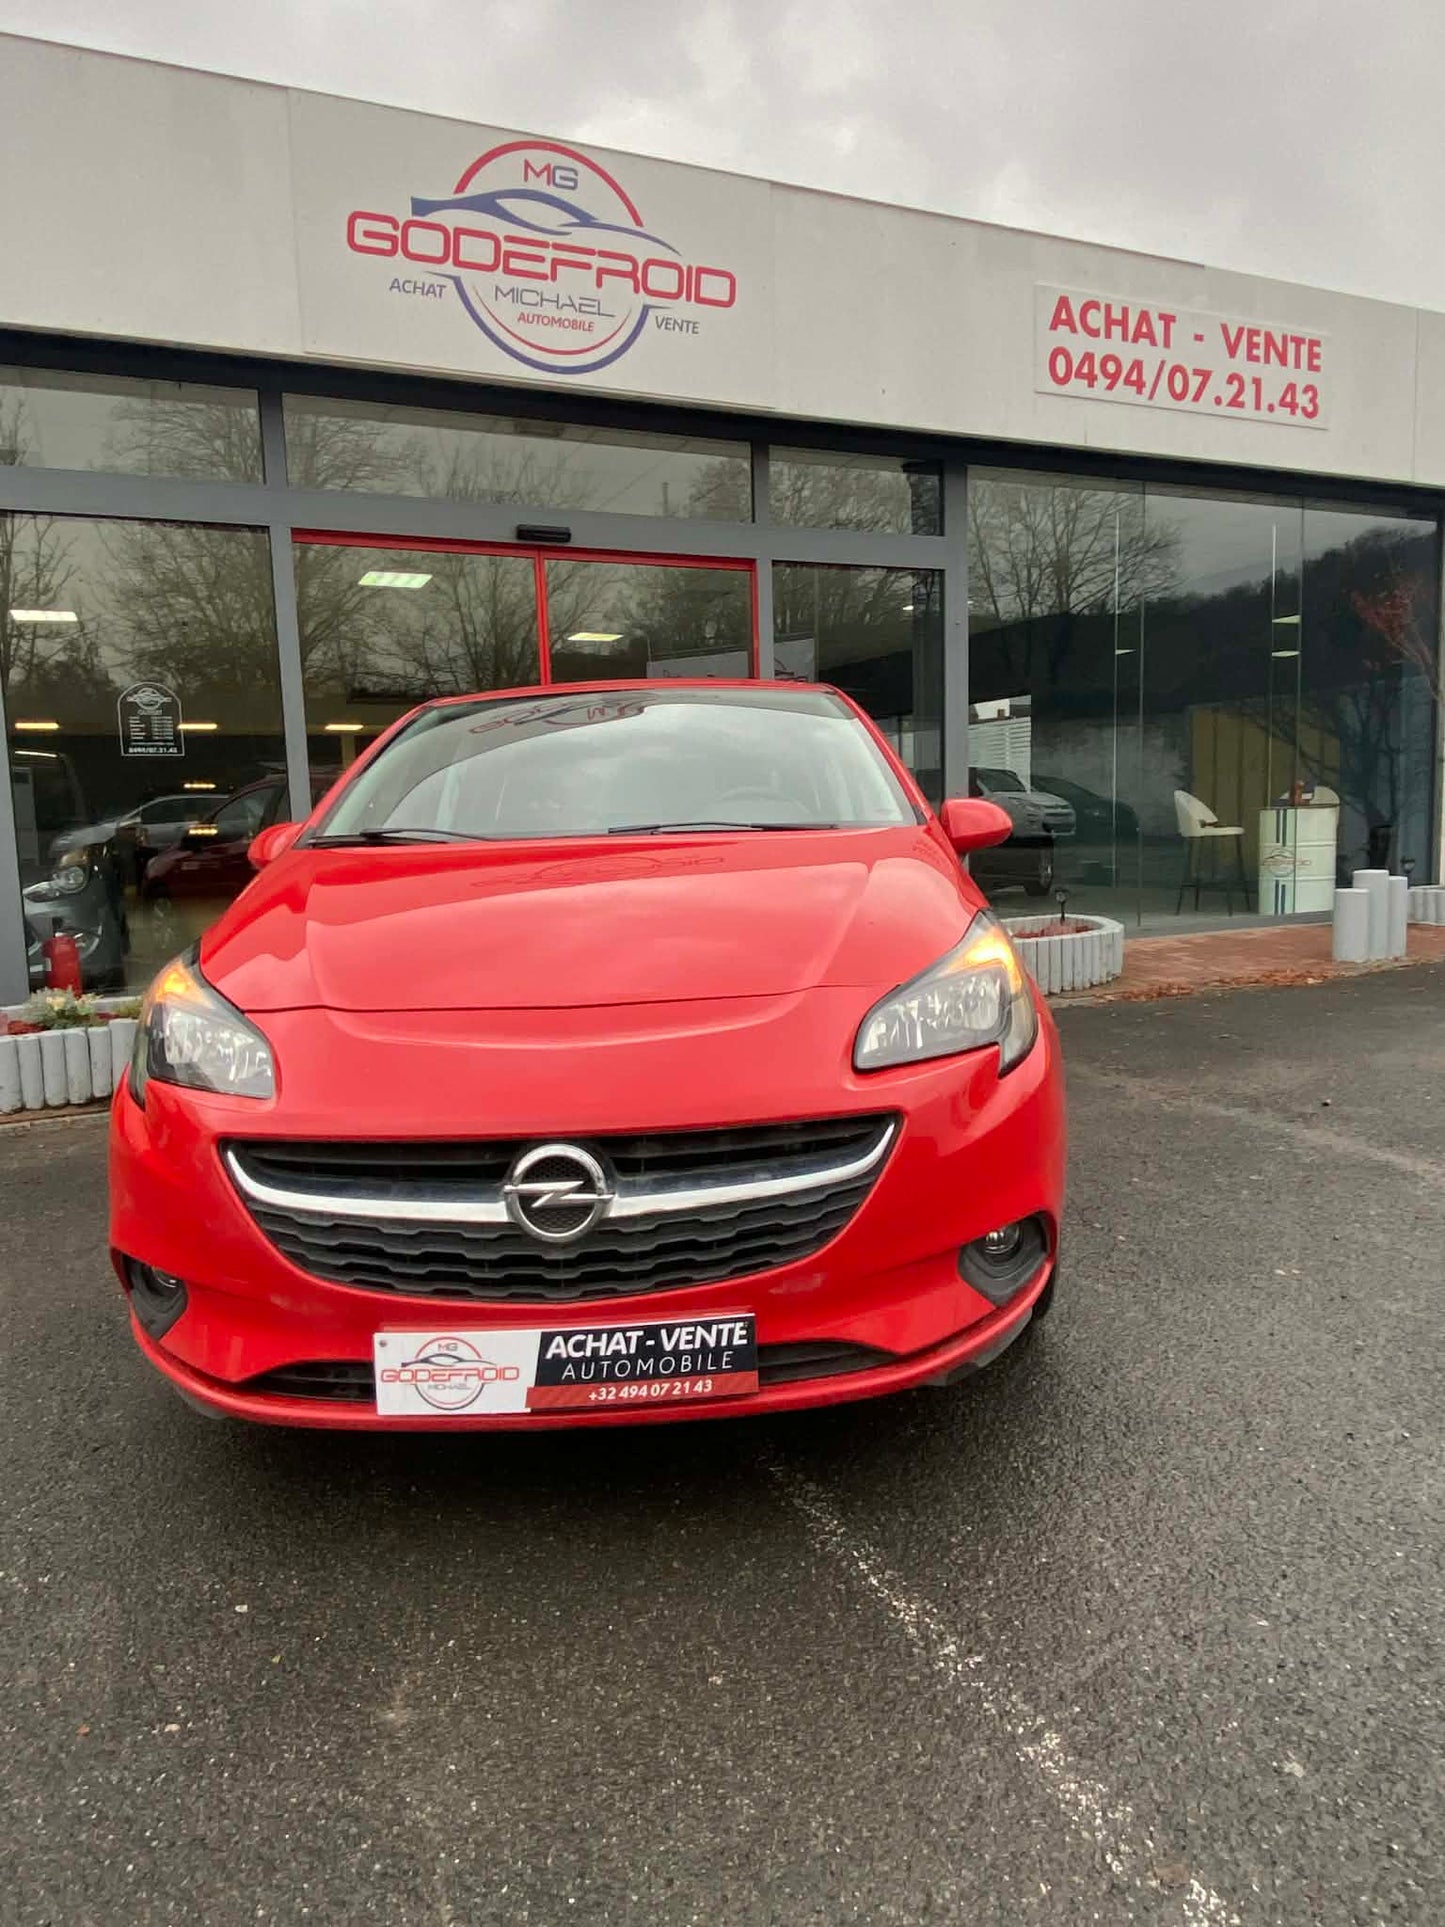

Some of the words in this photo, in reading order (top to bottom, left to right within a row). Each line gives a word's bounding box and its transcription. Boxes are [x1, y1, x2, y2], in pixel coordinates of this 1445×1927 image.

[524, 159, 578, 190] MG
[347, 210, 736, 308] GODEFROID
[389, 278, 447, 299] ACHAT
[495, 285, 616, 318] MICHAEL
[517, 311, 595, 333] AUTOMOBILE
[655, 315, 700, 335] VENTE
[1049, 295, 1176, 348] ACHAT
[1220, 322, 1321, 372] VENTE
[1048, 345, 1319, 419] 0494/07.21.43
[381, 1367, 520, 1382] GODEFROID
[561, 1350, 734, 1380] AUTOMOBILE
[588, 1385, 616, 1401] +32
[619, 1383, 648, 1399] 494
[651, 1382, 671, 1397] 07
[672, 1381, 690, 1395] 21
[692, 1379, 713, 1394] 43
